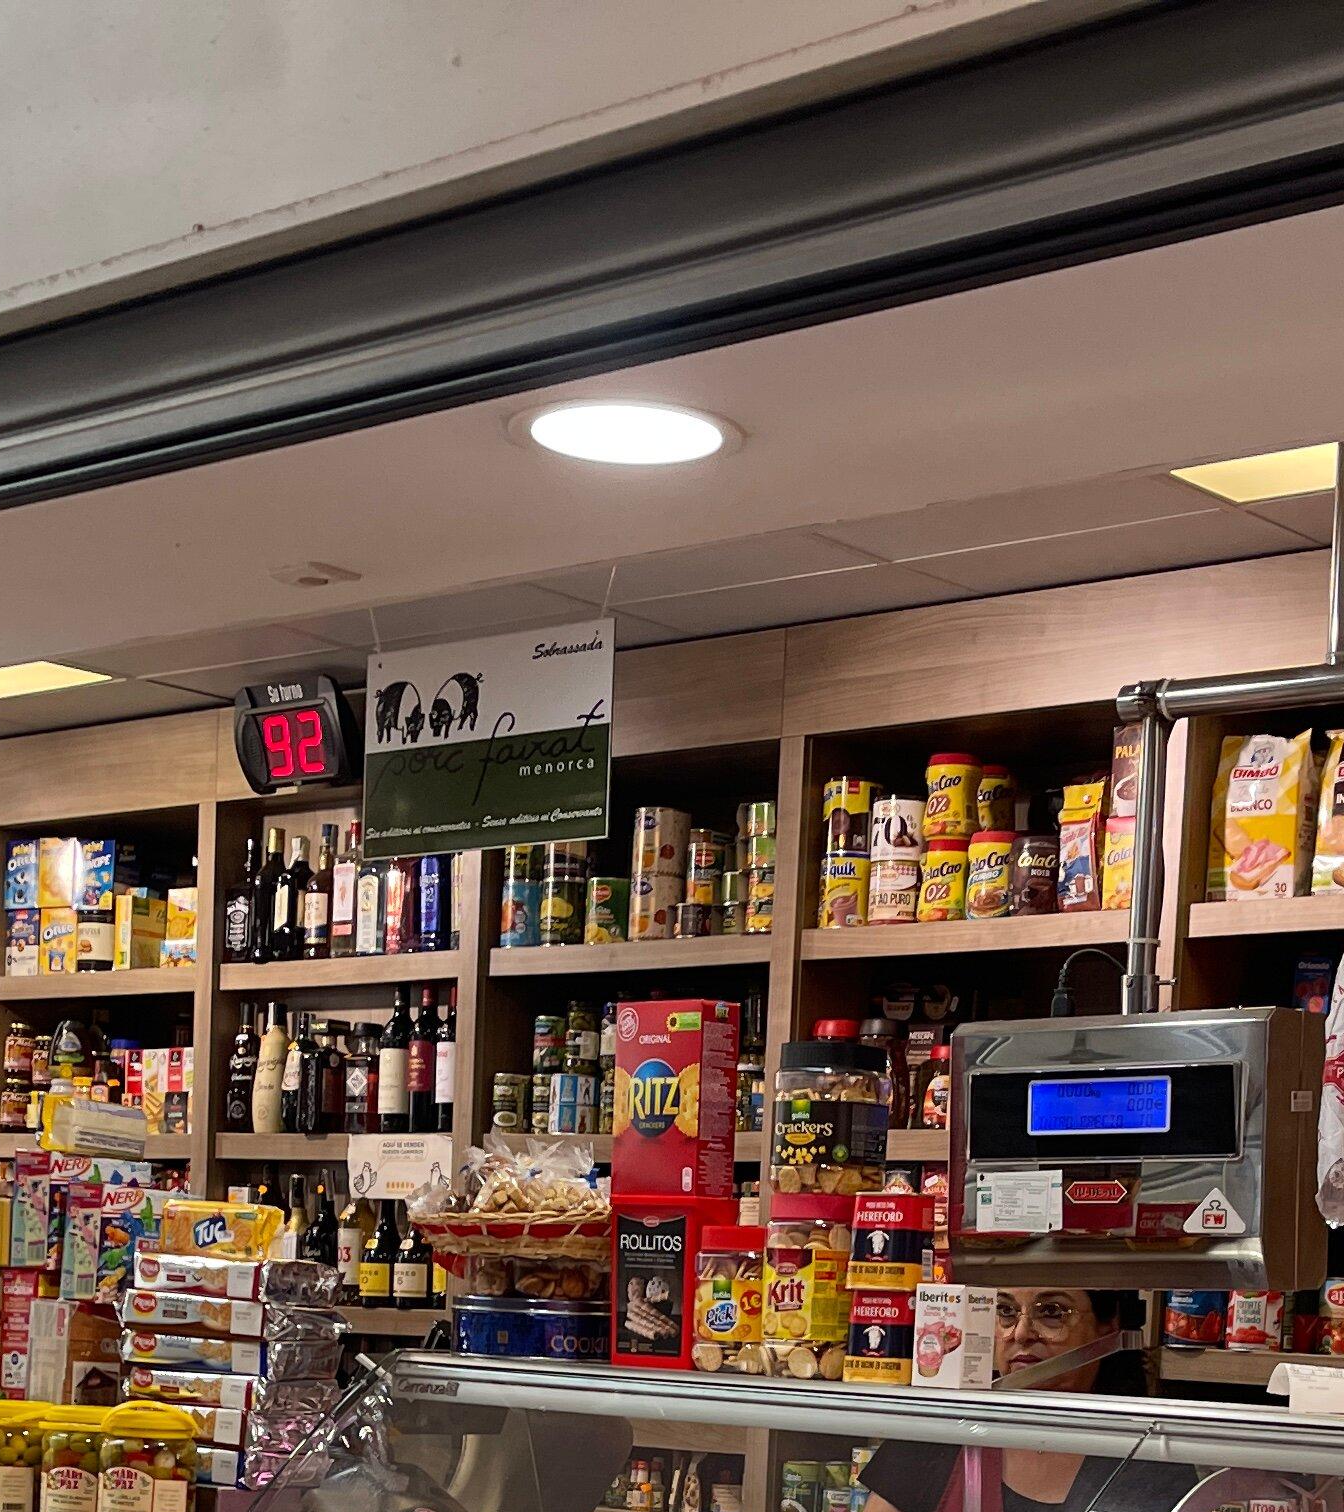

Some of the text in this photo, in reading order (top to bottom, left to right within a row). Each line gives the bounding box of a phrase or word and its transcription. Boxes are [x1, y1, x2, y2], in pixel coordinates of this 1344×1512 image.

[533, 637, 604, 661] Sobrassada
[263, 710, 325, 778] 92
[518, 757, 596, 777] menorca
[1232, 765, 1280, 780] BIMBO
[927, 793, 950, 817] 0%
[1273, 882, 1288, 893] 30
[42, 922, 75, 942] OREO
[638, 1033, 672, 1046] ORIGINAL
[627, 1075, 682, 1118] RITZ
[50, 1155, 93, 1174] NERF
[102, 1188, 144, 1207] NERF
[855, 1210, 904, 1223] HEREFORD
[1204, 1213, 1225, 1225] FW
[619, 1233, 683, 1252] ROLLITOS
[767, 1278, 805, 1308] Krit
[919, 1291, 962, 1305] Iberitos
[853, 1305, 900, 1318] HEREFORD
